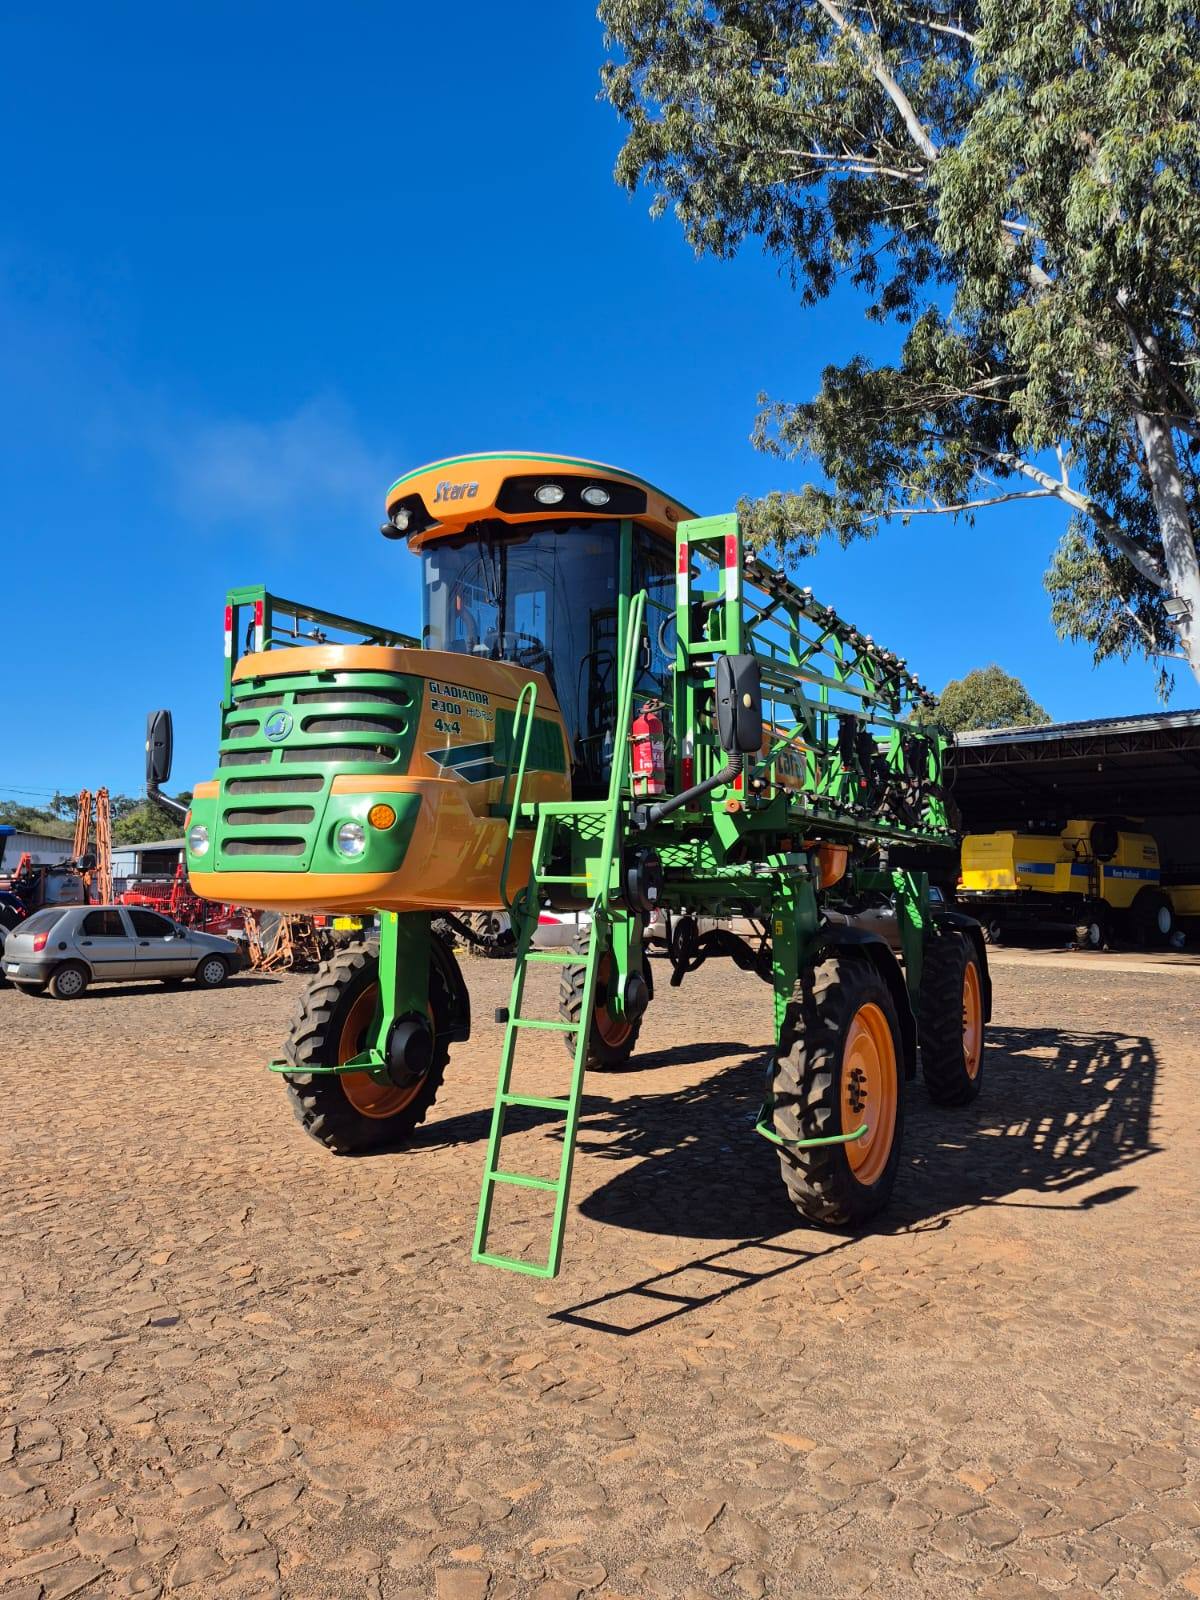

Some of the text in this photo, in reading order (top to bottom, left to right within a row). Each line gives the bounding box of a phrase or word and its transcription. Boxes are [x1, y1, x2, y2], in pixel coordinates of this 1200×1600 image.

[433, 480, 479, 503] Stara
[428, 681, 489, 705] GLADIADOR
[430, 699, 462, 715] 2300
[434, 718, 461, 734] 4x4
